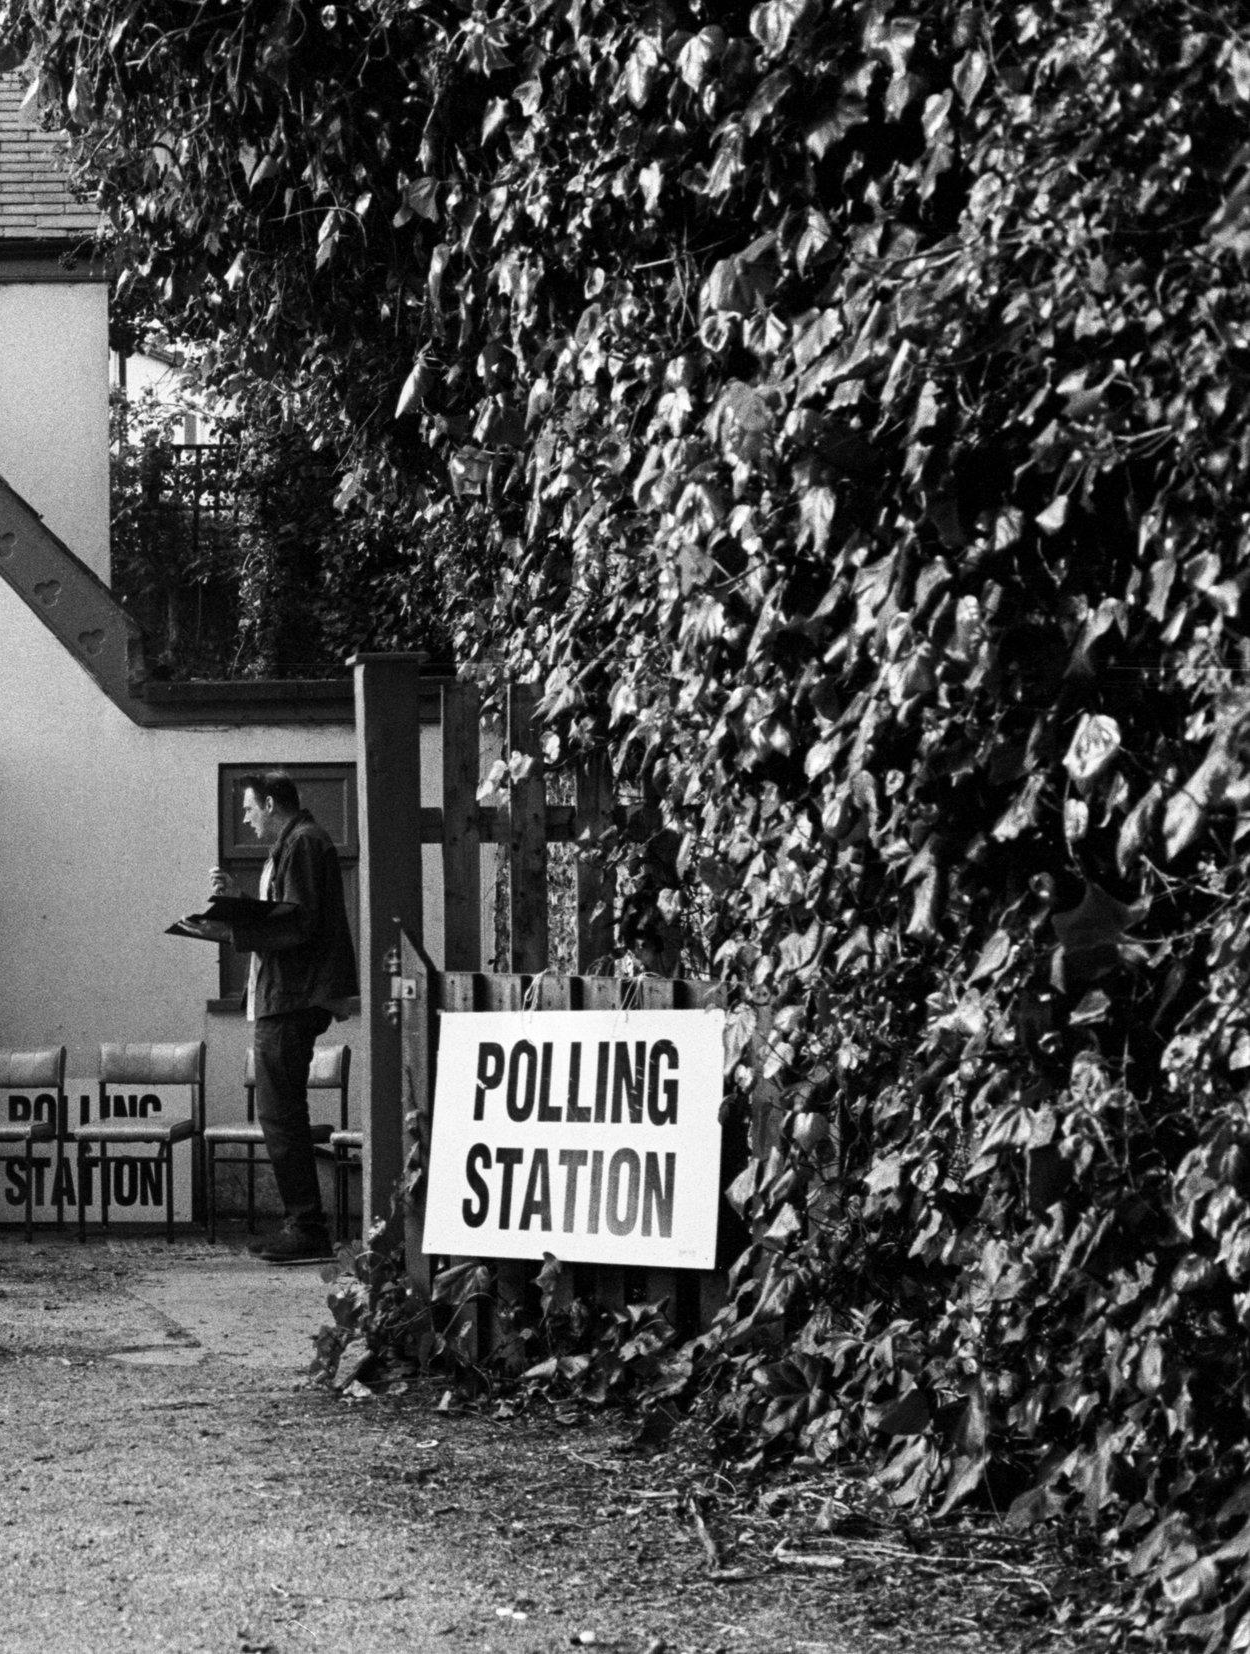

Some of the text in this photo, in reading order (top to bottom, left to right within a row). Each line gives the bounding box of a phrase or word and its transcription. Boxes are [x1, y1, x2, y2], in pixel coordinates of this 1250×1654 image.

[7, 1093, 163, 1142] POLL
[472, 1038, 680, 1127] POLLING
[461, 1141, 677, 1239] STATION
